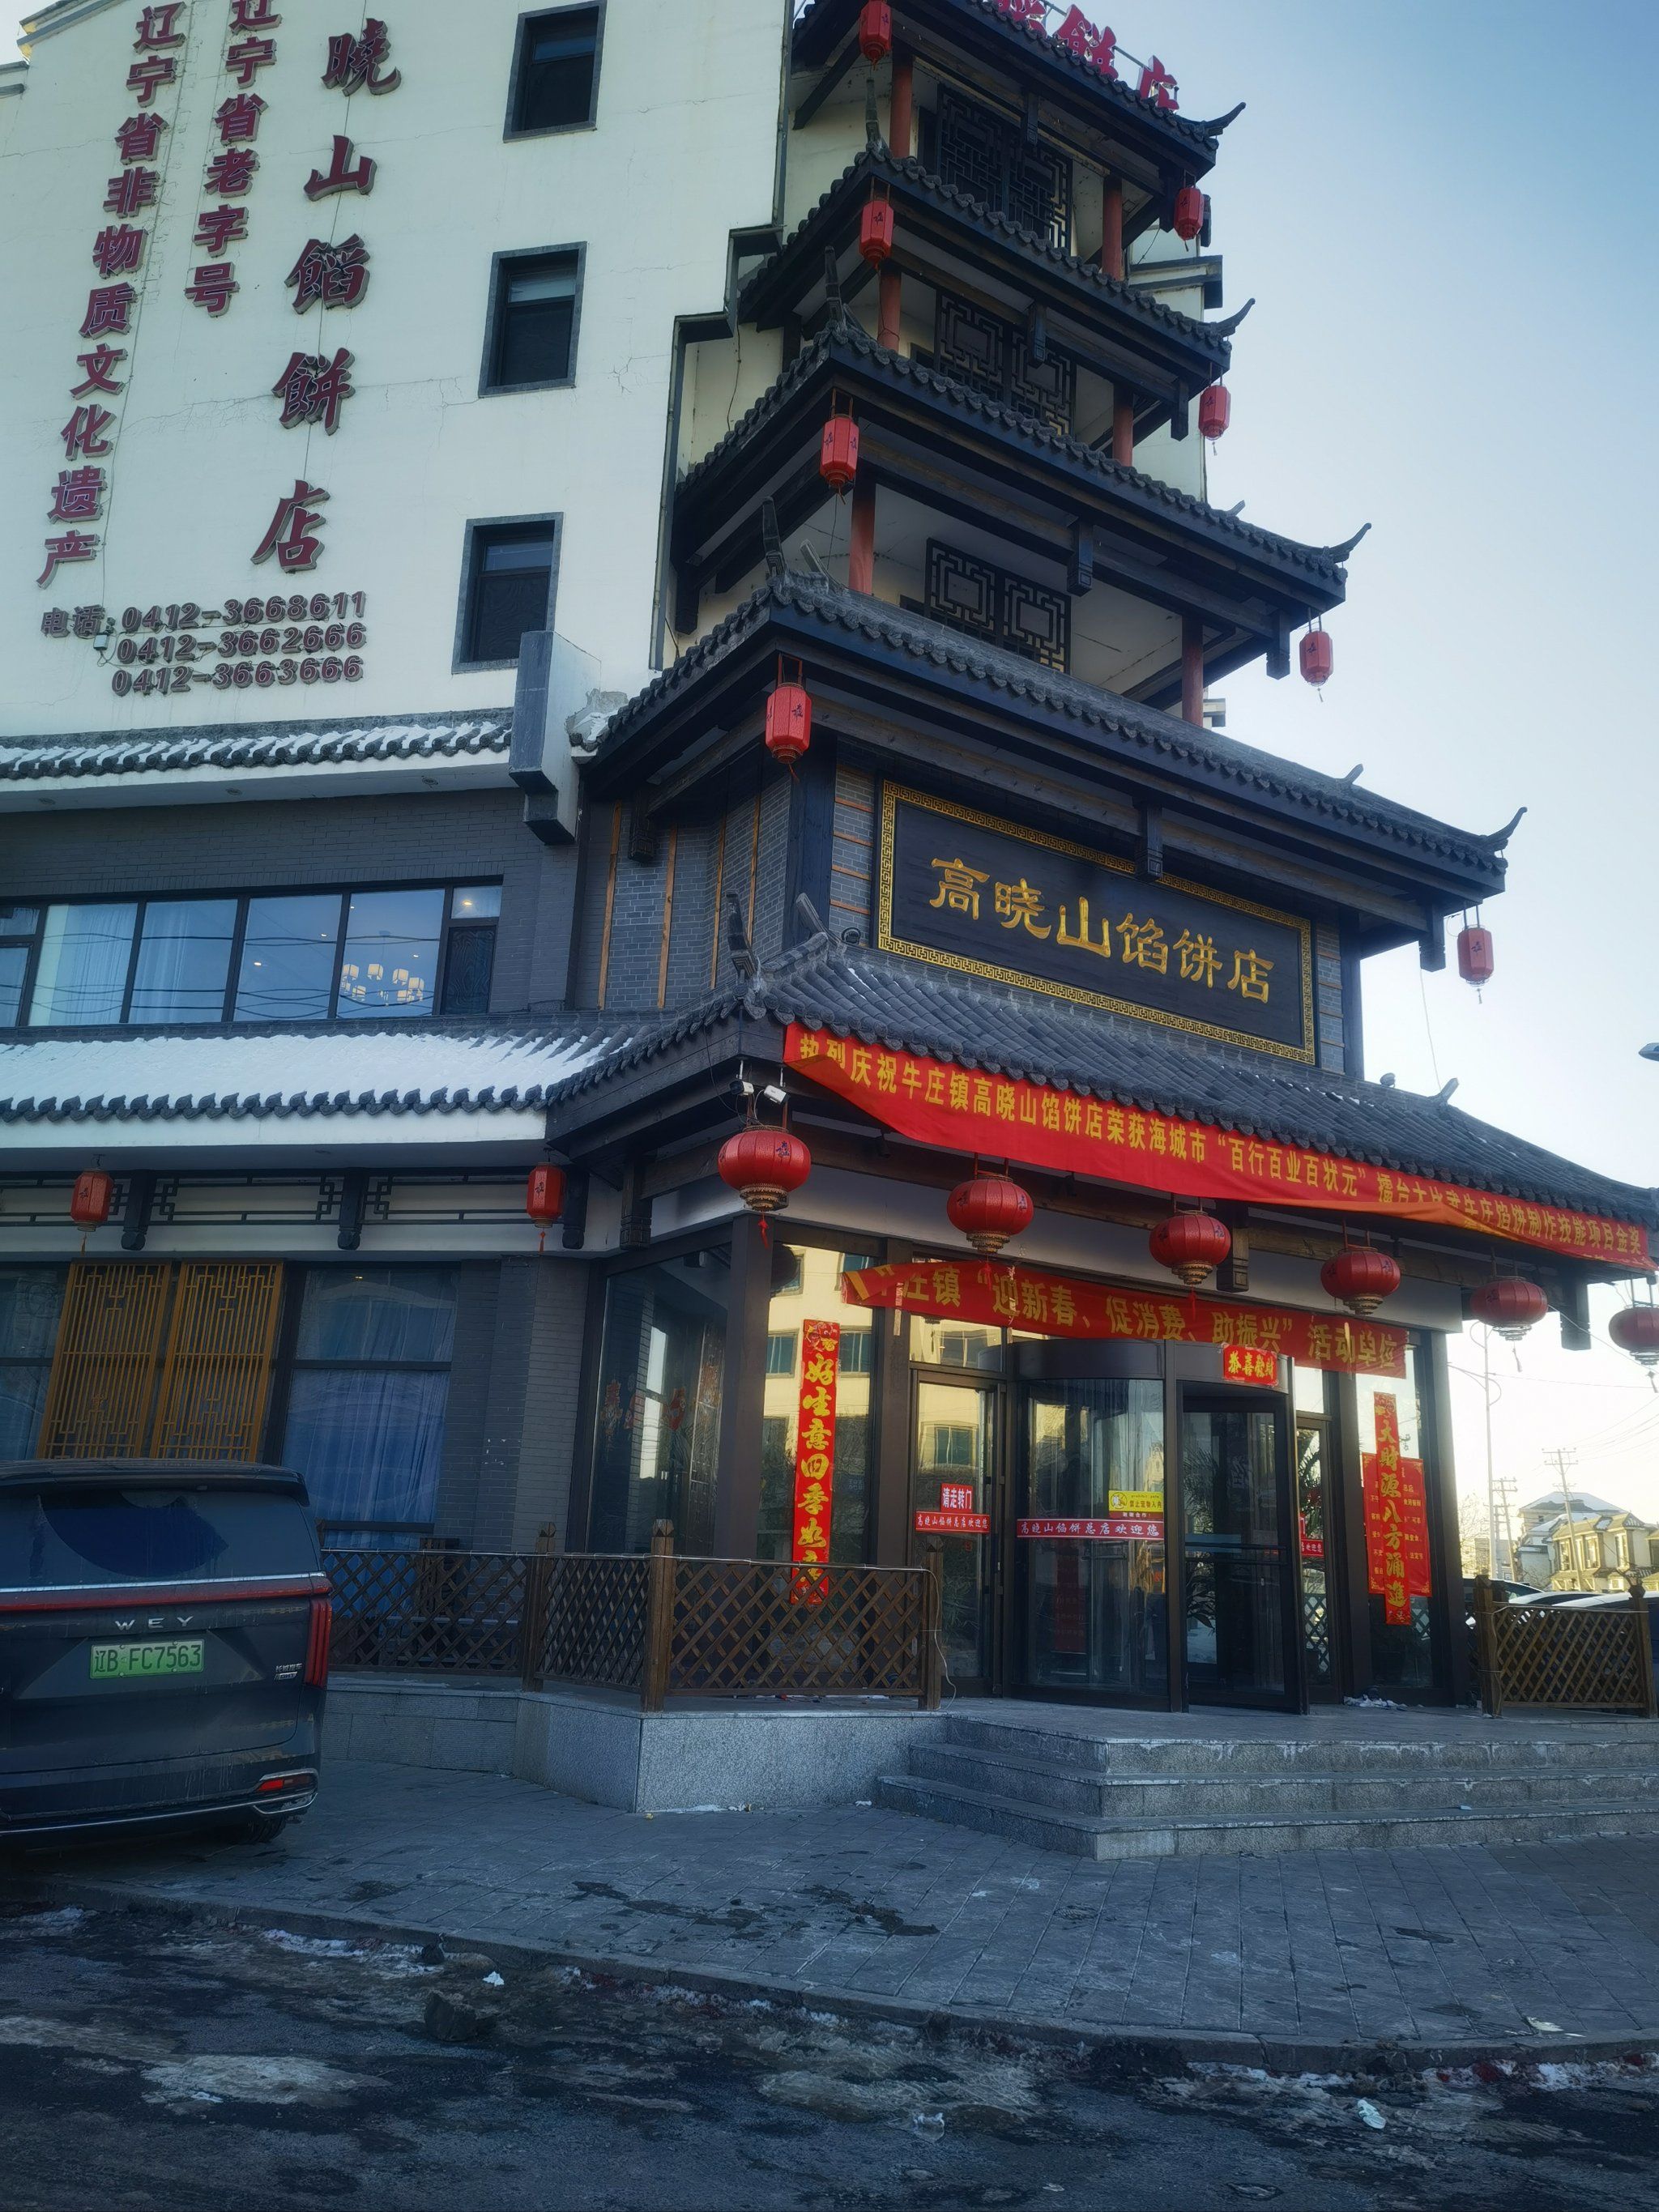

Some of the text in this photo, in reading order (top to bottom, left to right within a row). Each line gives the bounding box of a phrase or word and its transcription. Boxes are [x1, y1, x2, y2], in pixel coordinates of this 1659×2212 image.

[185, 0, 282, 318] 辽宁省老字号
[36, 0, 187, 590] 辽宁省非物质文化遗产
[117, 622, 367, 664] 0412-3662666
[112, 655, 364, 696] 0412-3663666
[929, 858, 1273, 1004] 高晓山馅饼店
[942, 1487, 972, 1509] 请走转门
[115, 1616, 194, 1630] WEY
